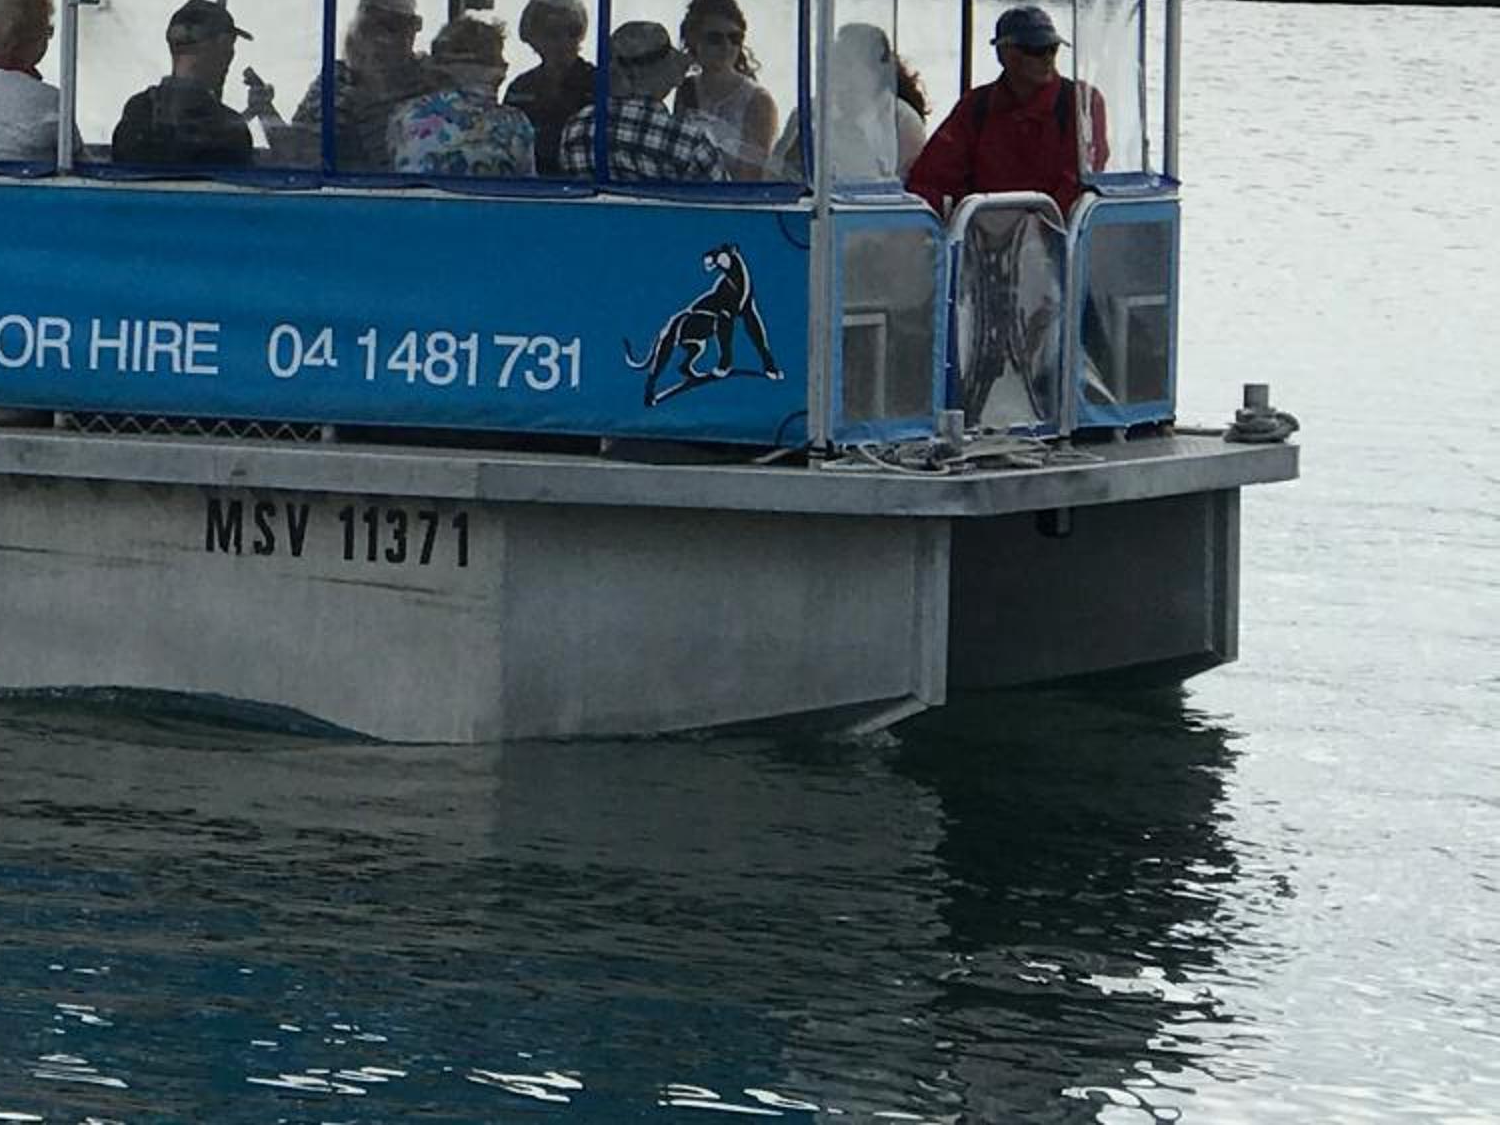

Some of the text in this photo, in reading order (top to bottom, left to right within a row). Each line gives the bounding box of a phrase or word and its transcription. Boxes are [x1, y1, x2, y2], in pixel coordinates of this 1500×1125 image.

[89, 318, 220, 375] HIRE
[267, 323, 339, 379] 04
[204, 498, 469, 567] MSV 11371
